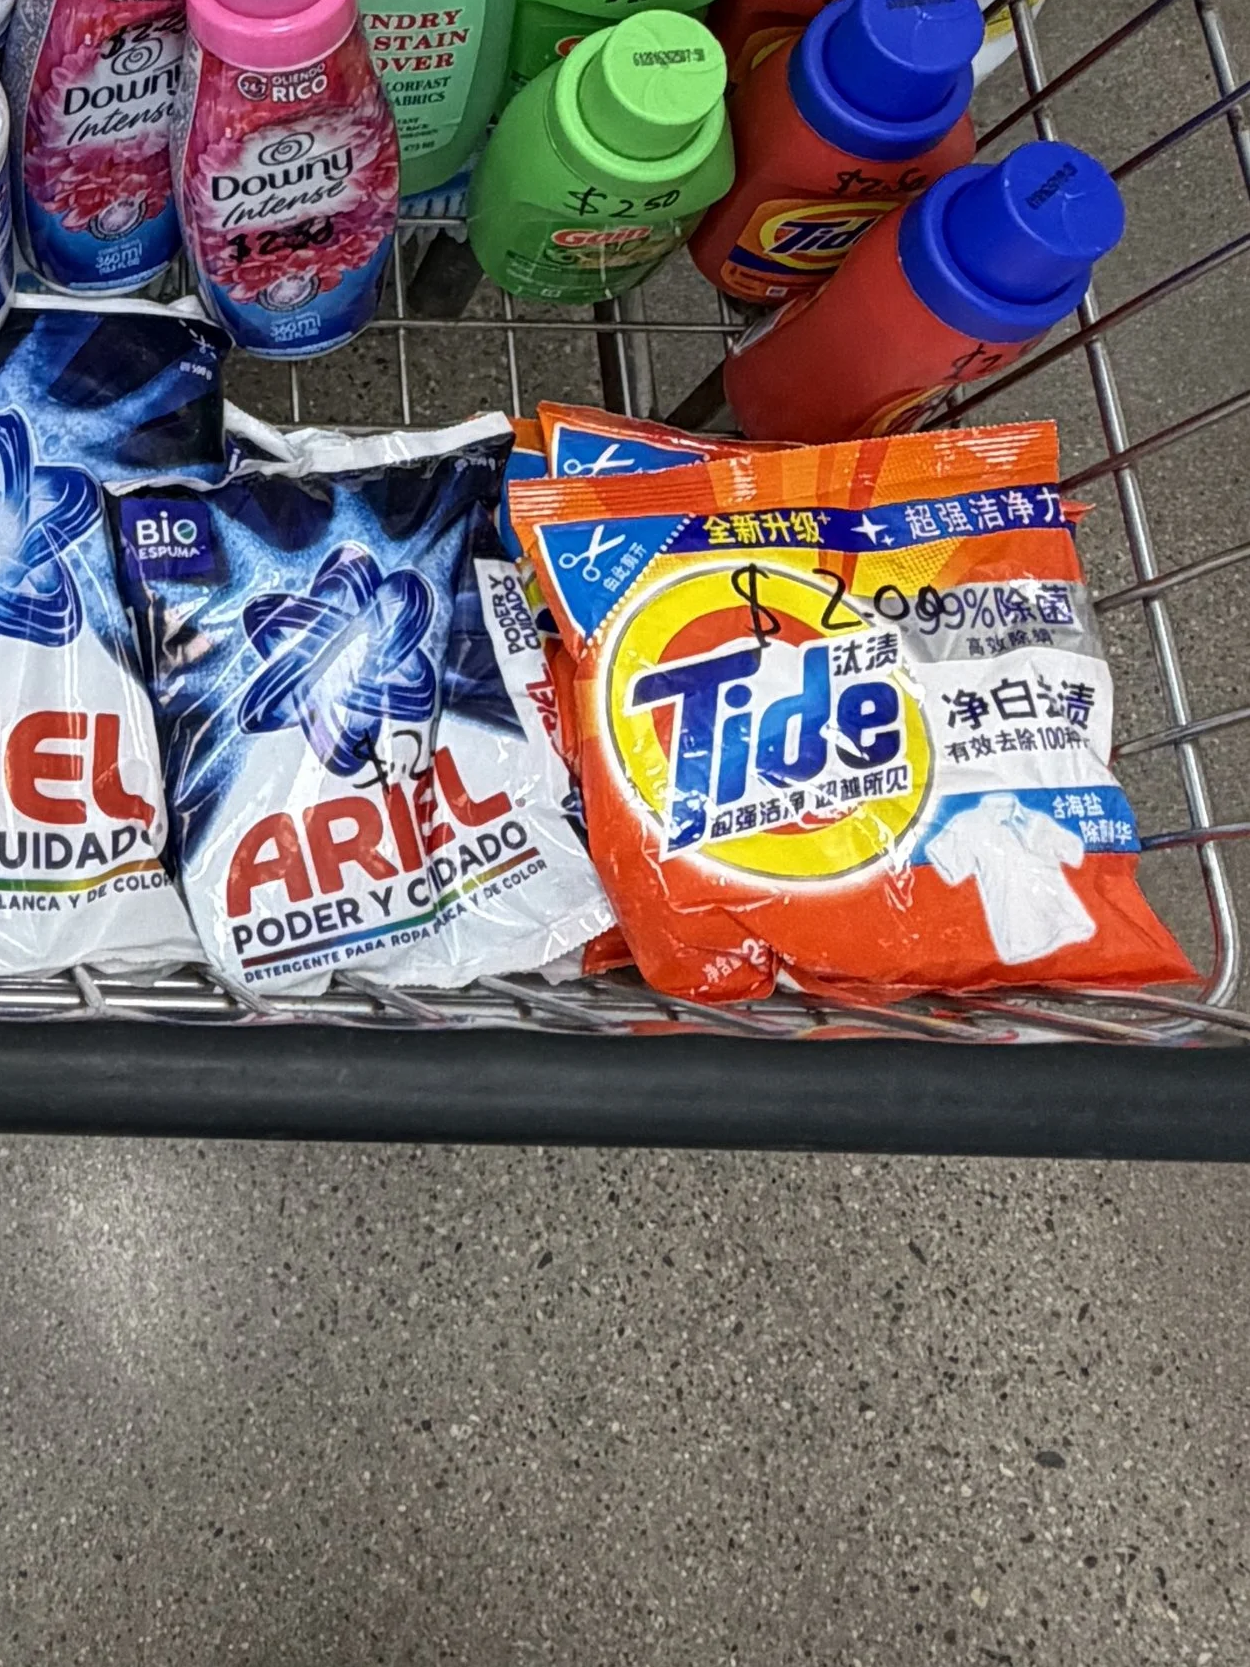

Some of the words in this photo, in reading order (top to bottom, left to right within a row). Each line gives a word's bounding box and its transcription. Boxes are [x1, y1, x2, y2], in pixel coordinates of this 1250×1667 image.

[362, 9, 464, 31] NDRY
[373, 28, 471, 52] STAIN
[271, 63, 326, 85] OLIENDO
[379, 52, 456, 73] OVER
[385, 76, 452, 93] LORFAST
[271, 75, 328, 103] RICO
[393, 91, 446, 107] ABRICS
[211, 147, 354, 201] Downy
[221, 177, 349, 229] Intense
[768, 215, 879, 255] Tid
[905, 487, 1067, 538] 超强洁净力
[138, 543, 200, 560] ESPUMA
[488, 573, 503, 592] Y
[492, 593, 525, 656] PODER
[502, 574, 542, 652] CUIDADO
[730, 563, 946, 649] $2.00
[832, 631, 904, 677] 汰渍
[525, 661, 560, 738] RIEL
[631, 640, 902, 853] Tide
[226, 745, 514, 919] ARIEL
[67, 893, 81, 911] Y
[86, 883, 109, 906] DE
[232, 890, 363, 955] PODER
[365, 887, 395, 918] Y
[243, 951, 342, 984] DETERGENTE
[345, 937, 388, 958] PARA
[390, 925, 433, 948] ROPA
[471, 893, 481, 908] Y
[484, 881, 501, 899] DE
[502, 859, 548, 892] COLOR
